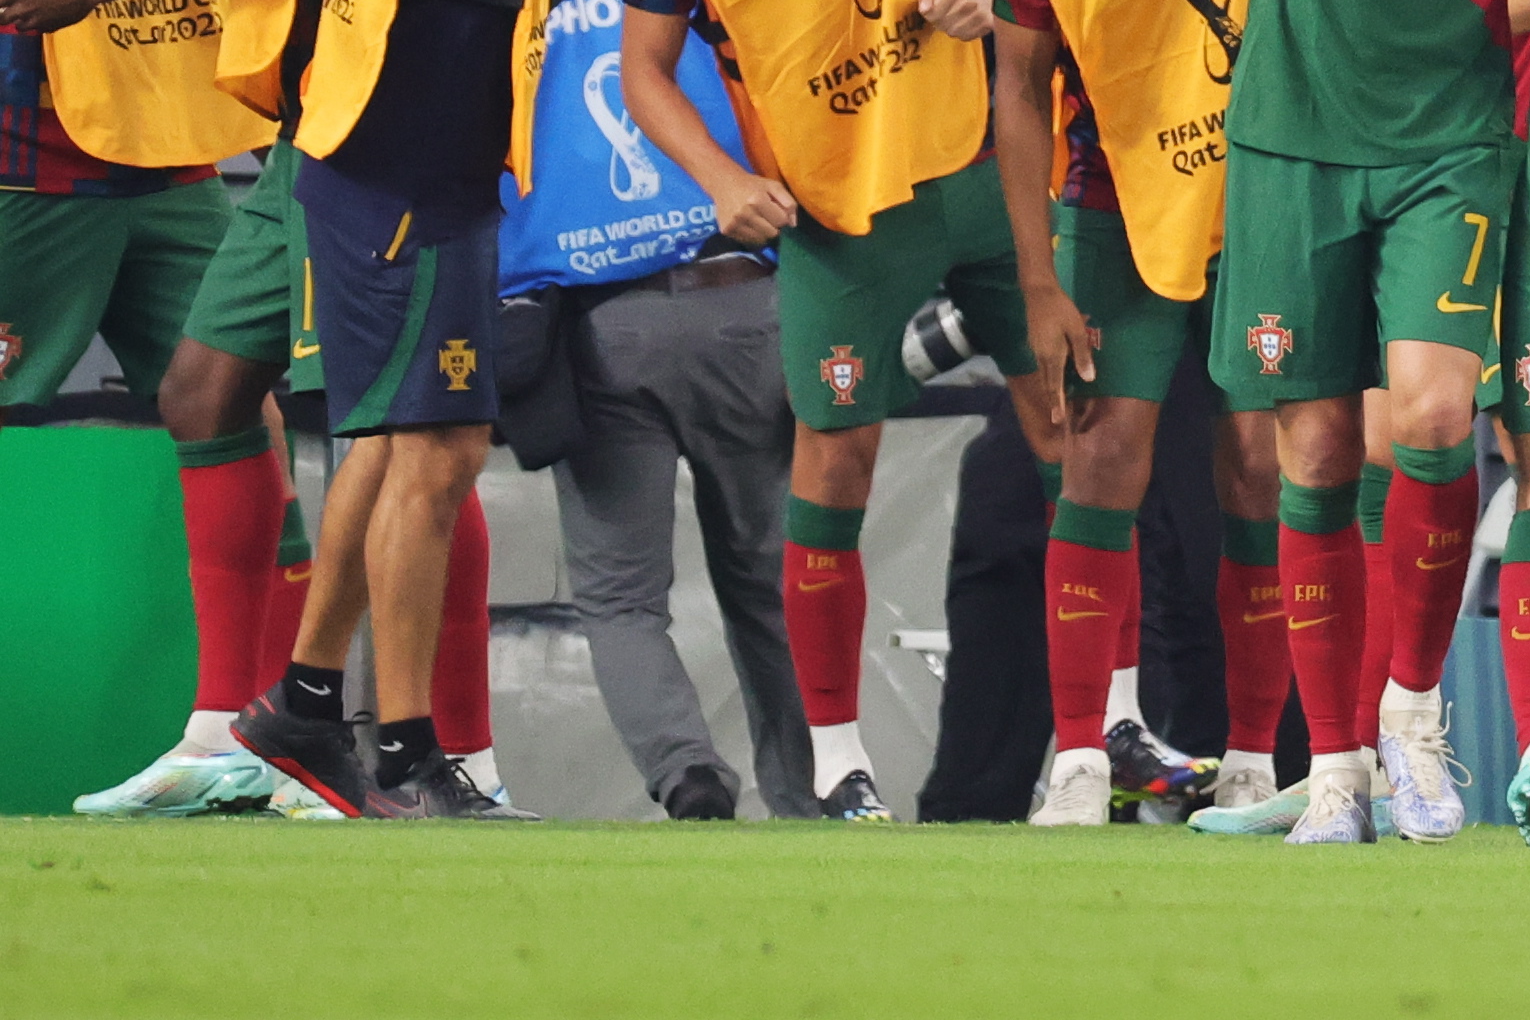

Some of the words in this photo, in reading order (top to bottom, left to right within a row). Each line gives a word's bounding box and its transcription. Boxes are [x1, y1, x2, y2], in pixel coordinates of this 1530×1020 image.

[806, 58, 864, 98] FIFA
[1157, 120, 1203, 152] FIFA
[556, 226, 606, 252] FIFA
[604, 209, 686, 242] WORLD
[687, 203, 716, 225] CU
[1463, 212, 1489, 287] 7
